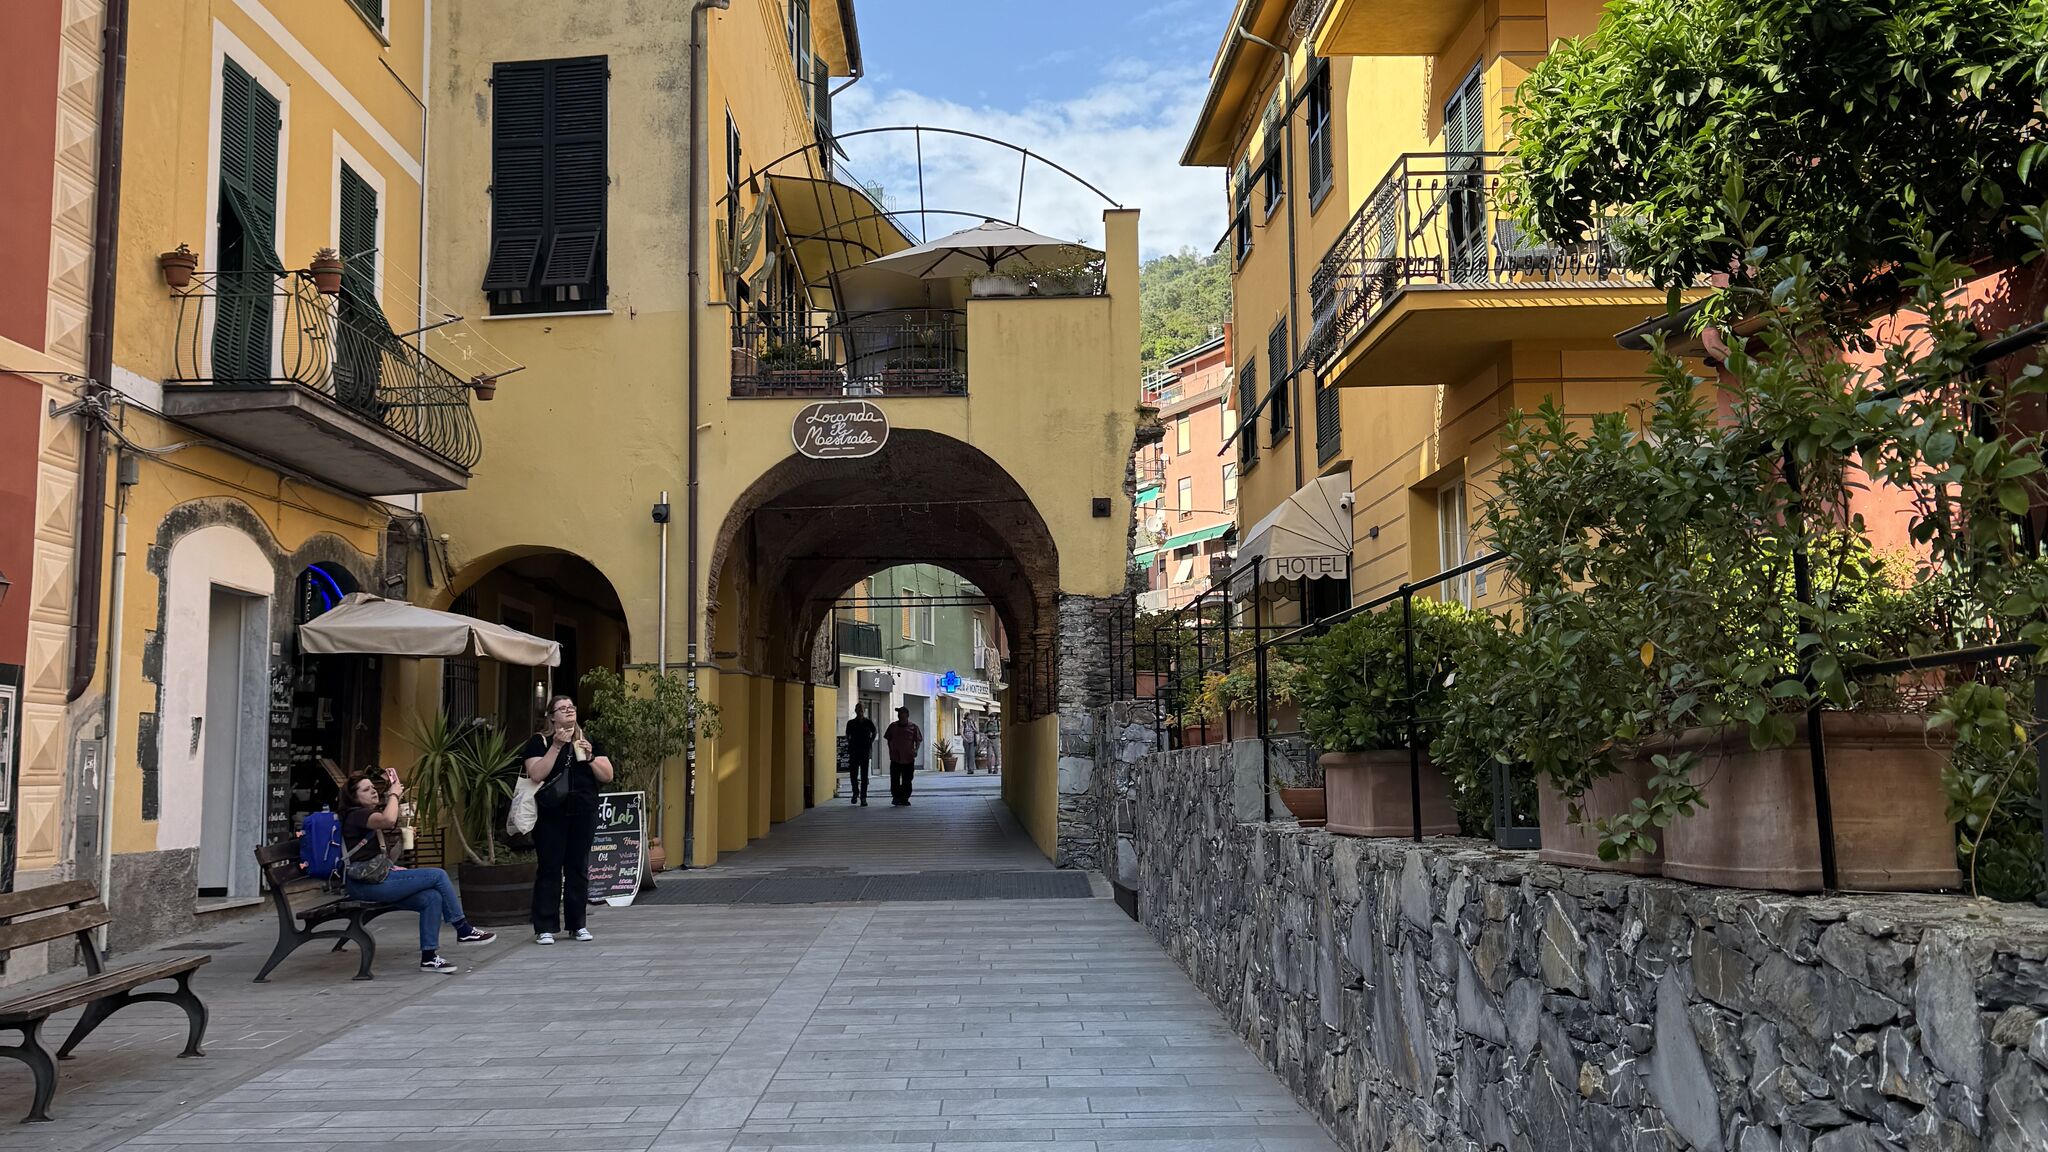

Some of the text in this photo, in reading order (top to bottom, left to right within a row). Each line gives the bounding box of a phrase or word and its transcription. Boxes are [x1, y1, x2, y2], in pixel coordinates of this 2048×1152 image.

[806, 402, 883, 424] Locanda
[801, 425, 877, 448] Maestrale
[1276, 557, 1343, 574] HOTEL
[609, 806, 634, 826] Lab
[598, 853, 608, 861] Oil
